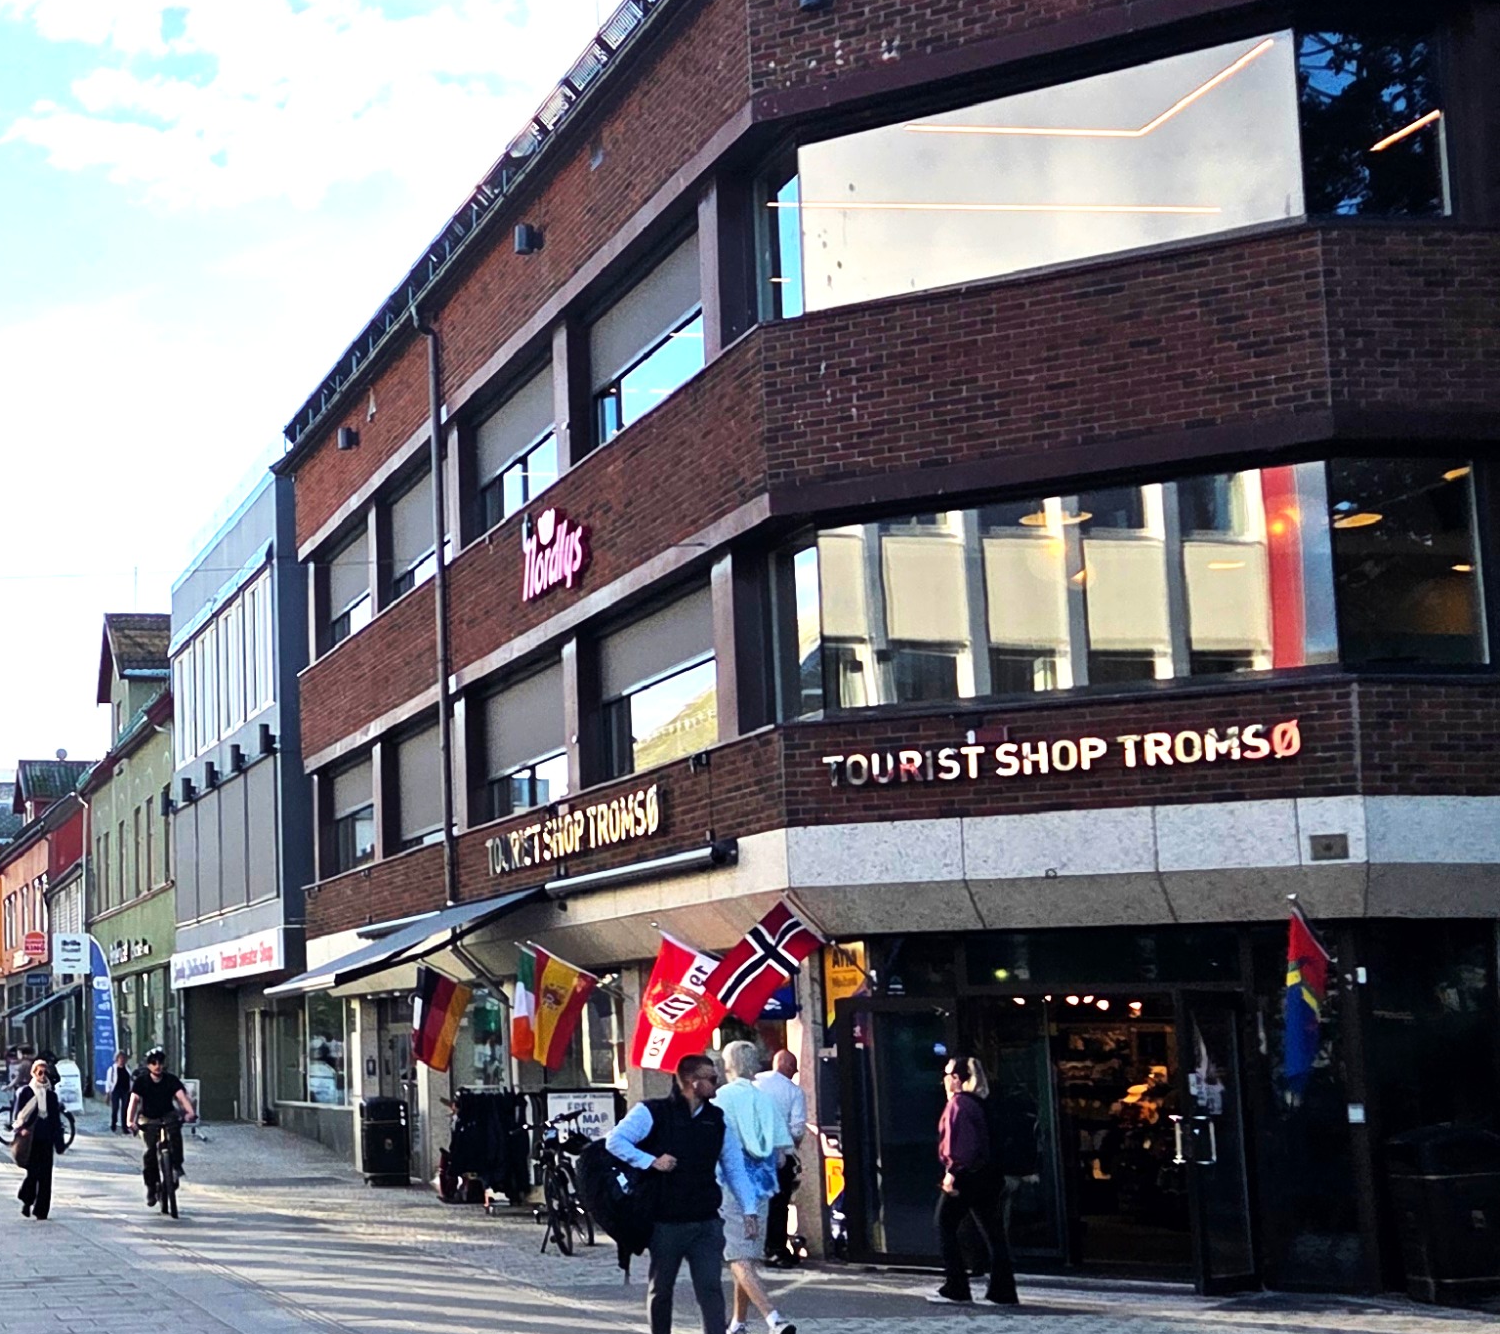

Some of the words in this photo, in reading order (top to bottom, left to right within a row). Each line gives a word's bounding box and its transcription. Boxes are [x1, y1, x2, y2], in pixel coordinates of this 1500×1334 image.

[821, 745, 986, 787] TOURIST
[994, 737, 1108, 778] SHOP
[1115, 719, 1301, 768] TROMSØ
[485, 823, 542, 877] TOURIST
[542, 809, 584, 861] SHOP
[586, 783, 659, 849] TROMSØ
[567, 1101, 595, 1113] FREE
[582, 1112, 609, 1124] MAP
